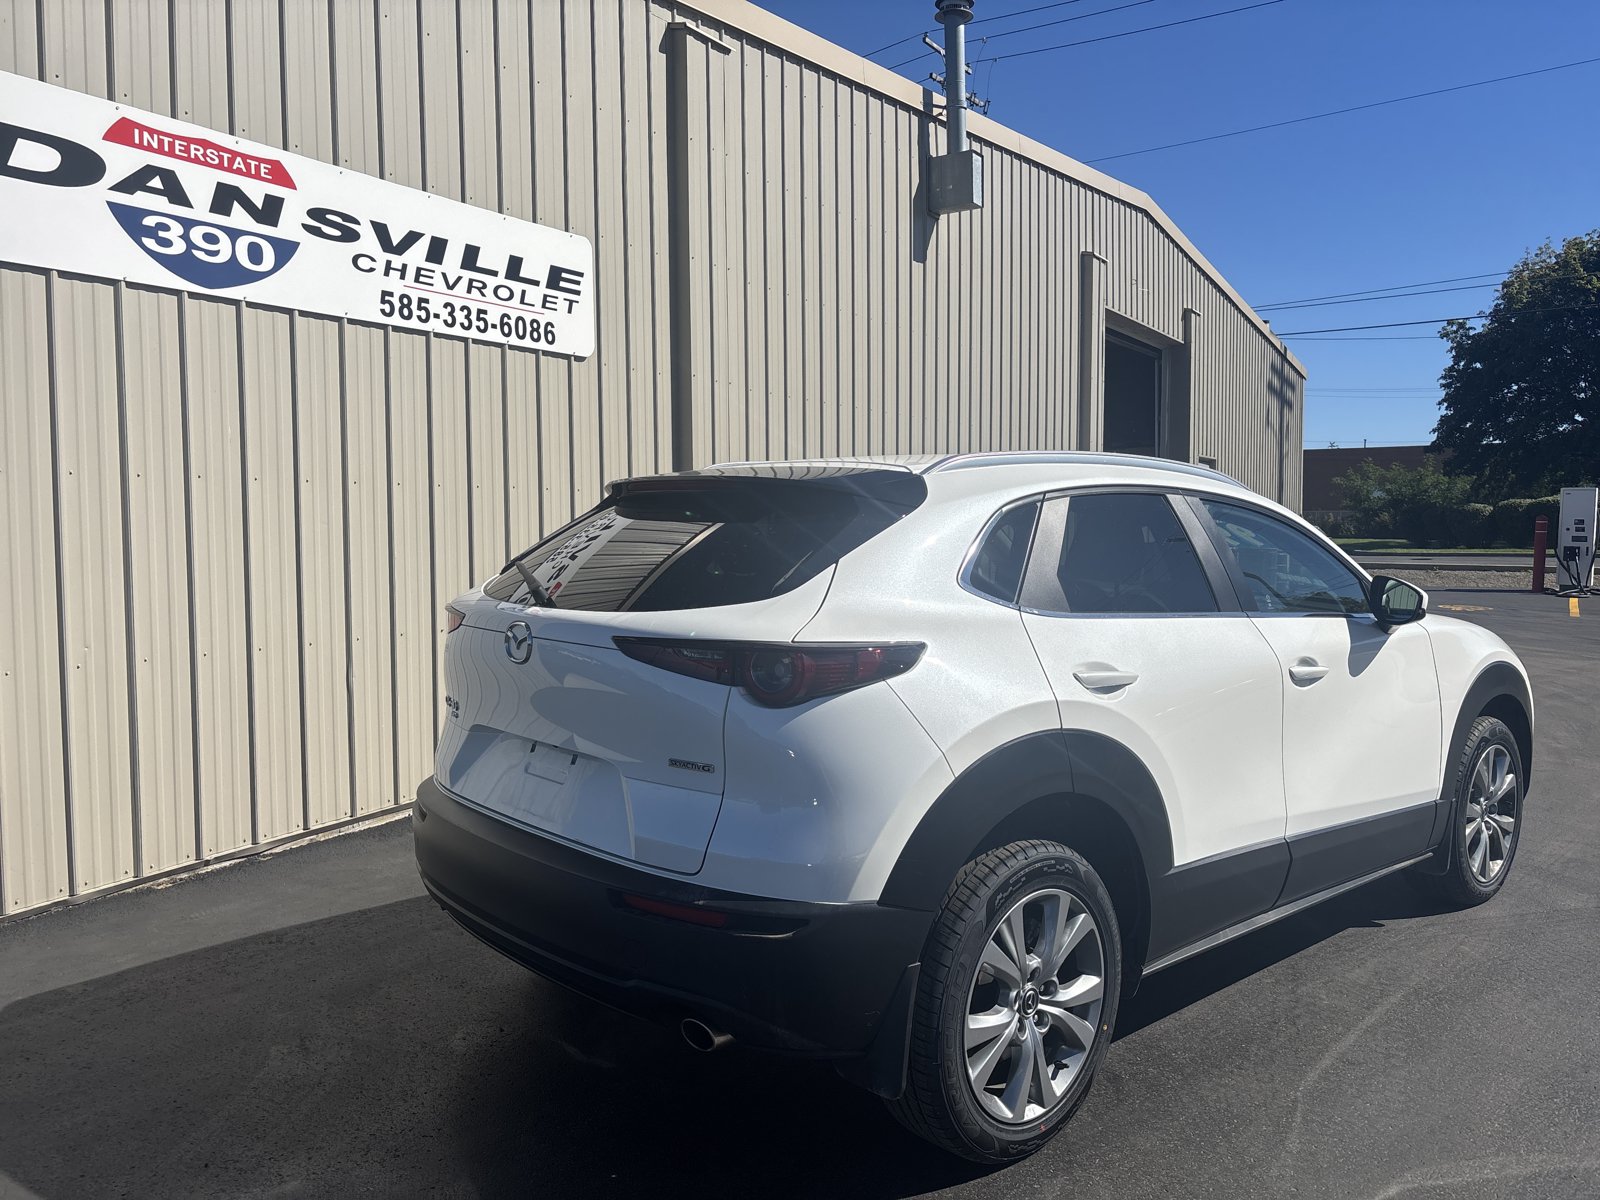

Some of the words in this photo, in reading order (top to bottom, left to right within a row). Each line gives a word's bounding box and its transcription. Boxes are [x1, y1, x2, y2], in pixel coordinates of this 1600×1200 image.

[133, 128, 273, 180] INTERSTATE
[0, 122, 584, 296] DANSVILLE
[141, 215, 276, 273] 390
[351, 253, 579, 315] CHEVROLET
[379, 289, 556, 346] 585-335-6086
